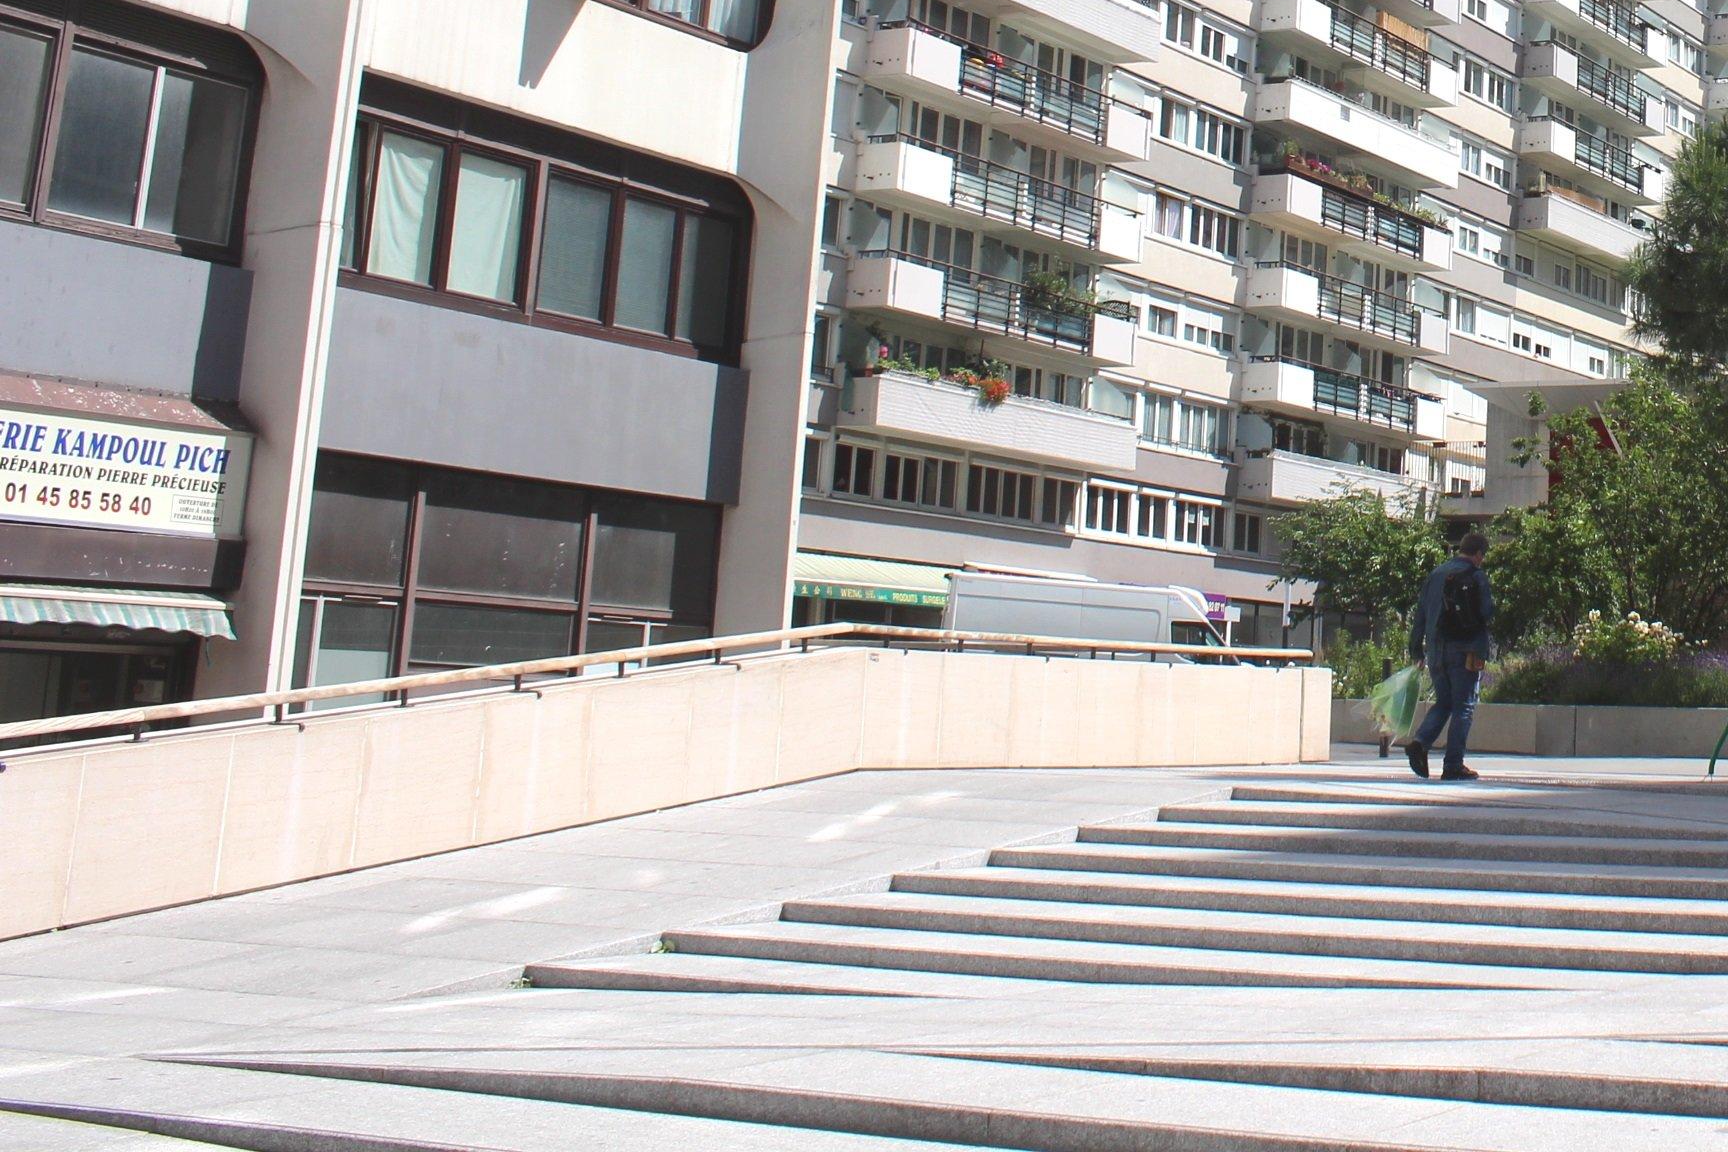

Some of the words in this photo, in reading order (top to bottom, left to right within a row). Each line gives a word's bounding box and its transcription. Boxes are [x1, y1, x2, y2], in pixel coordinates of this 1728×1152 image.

[52, 428, 167, 468] KAMPOUL
[173, 443, 231, 475] PICH
[0, 455, 93, 479] RÉPARATION
[96, 467, 148, 486] PIERRE
[151, 473, 227, 495] PRÉCIEUSE
[5, 482, 27, 504] 01
[36, 485, 61, 507] 45
[69, 489, 92, 510] 85
[99, 492, 122, 513] 58
[129, 496, 152, 516] 40
[892, 592, 918, 603] PRODUITS
